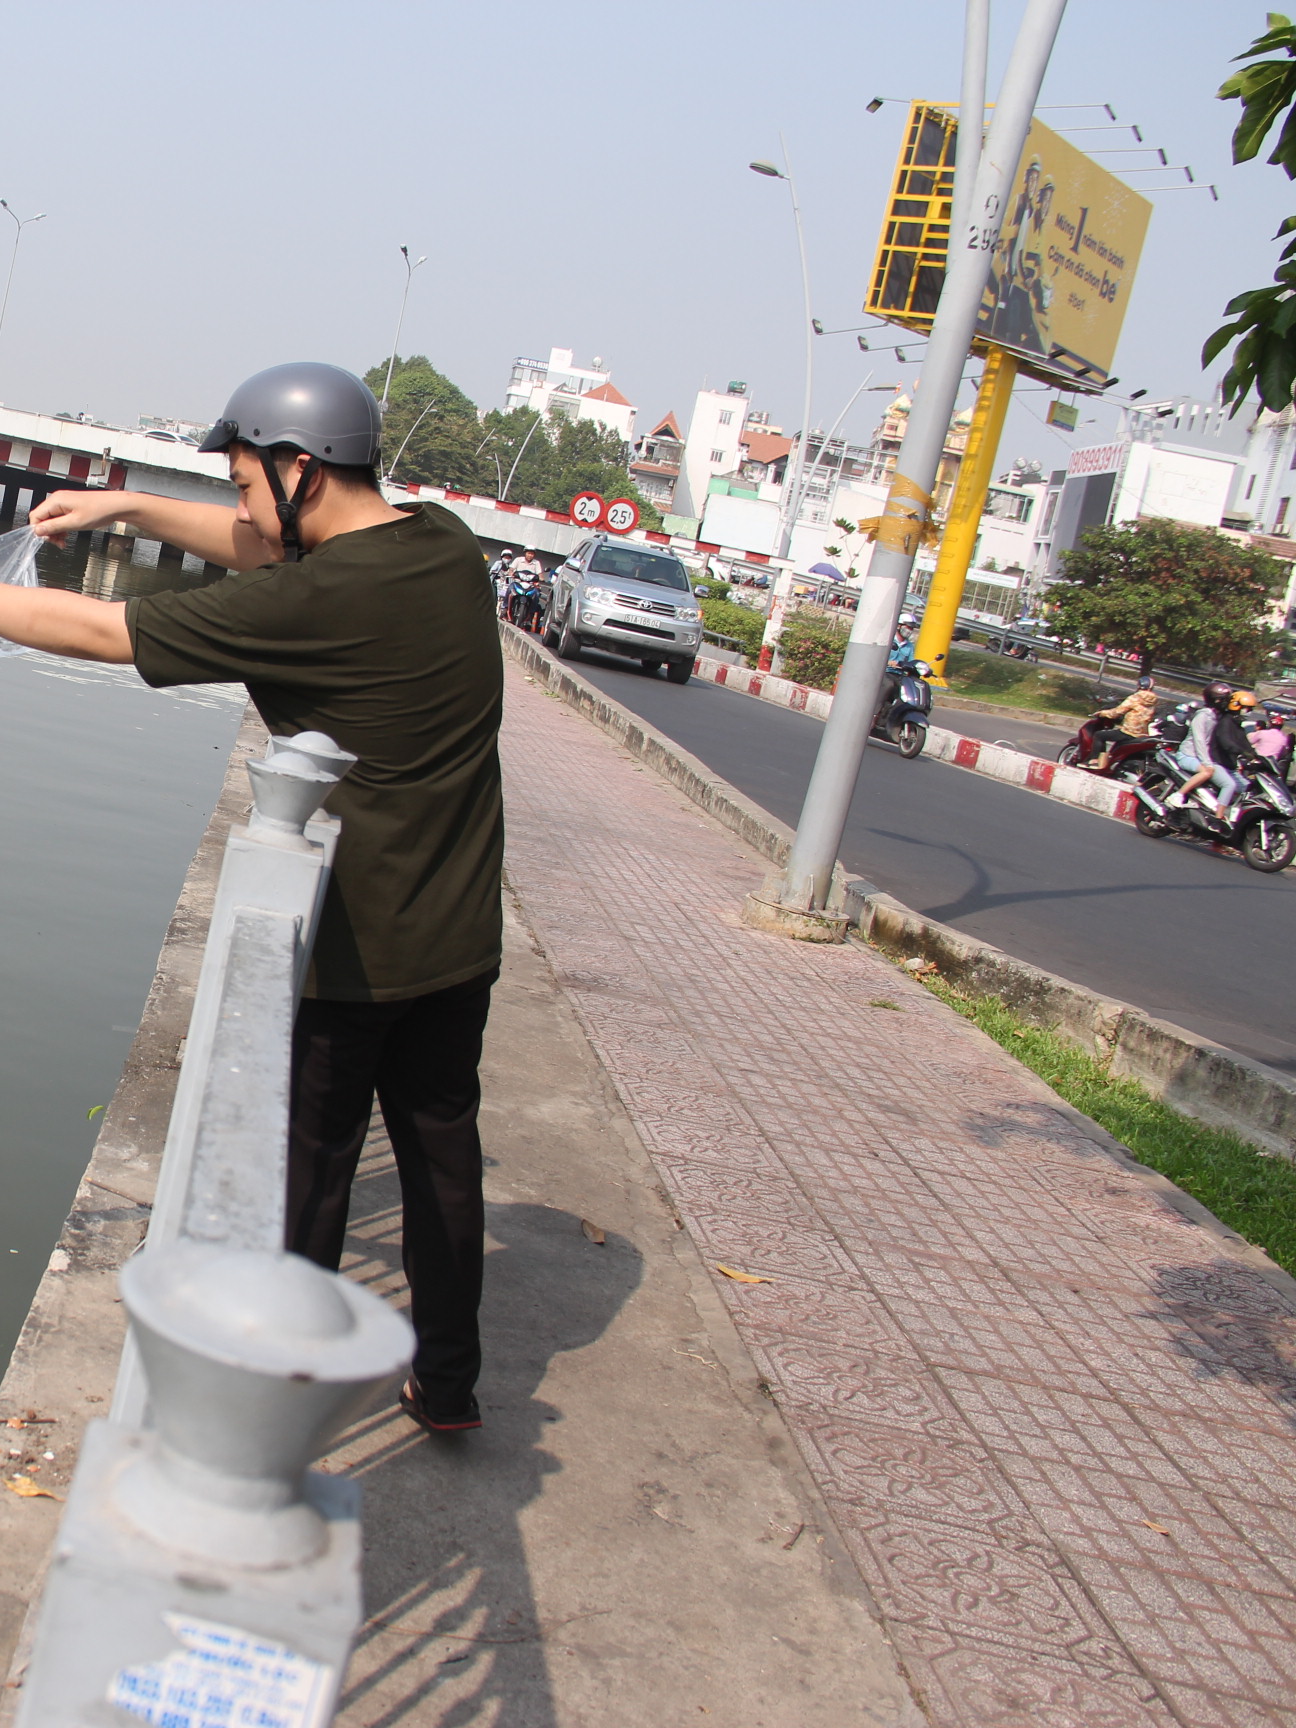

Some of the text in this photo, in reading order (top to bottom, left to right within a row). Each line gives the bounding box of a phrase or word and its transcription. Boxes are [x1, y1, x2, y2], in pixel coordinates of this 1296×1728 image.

[1069, 206, 1089, 256] 1
[578, 501, 596, 518] 2 m
